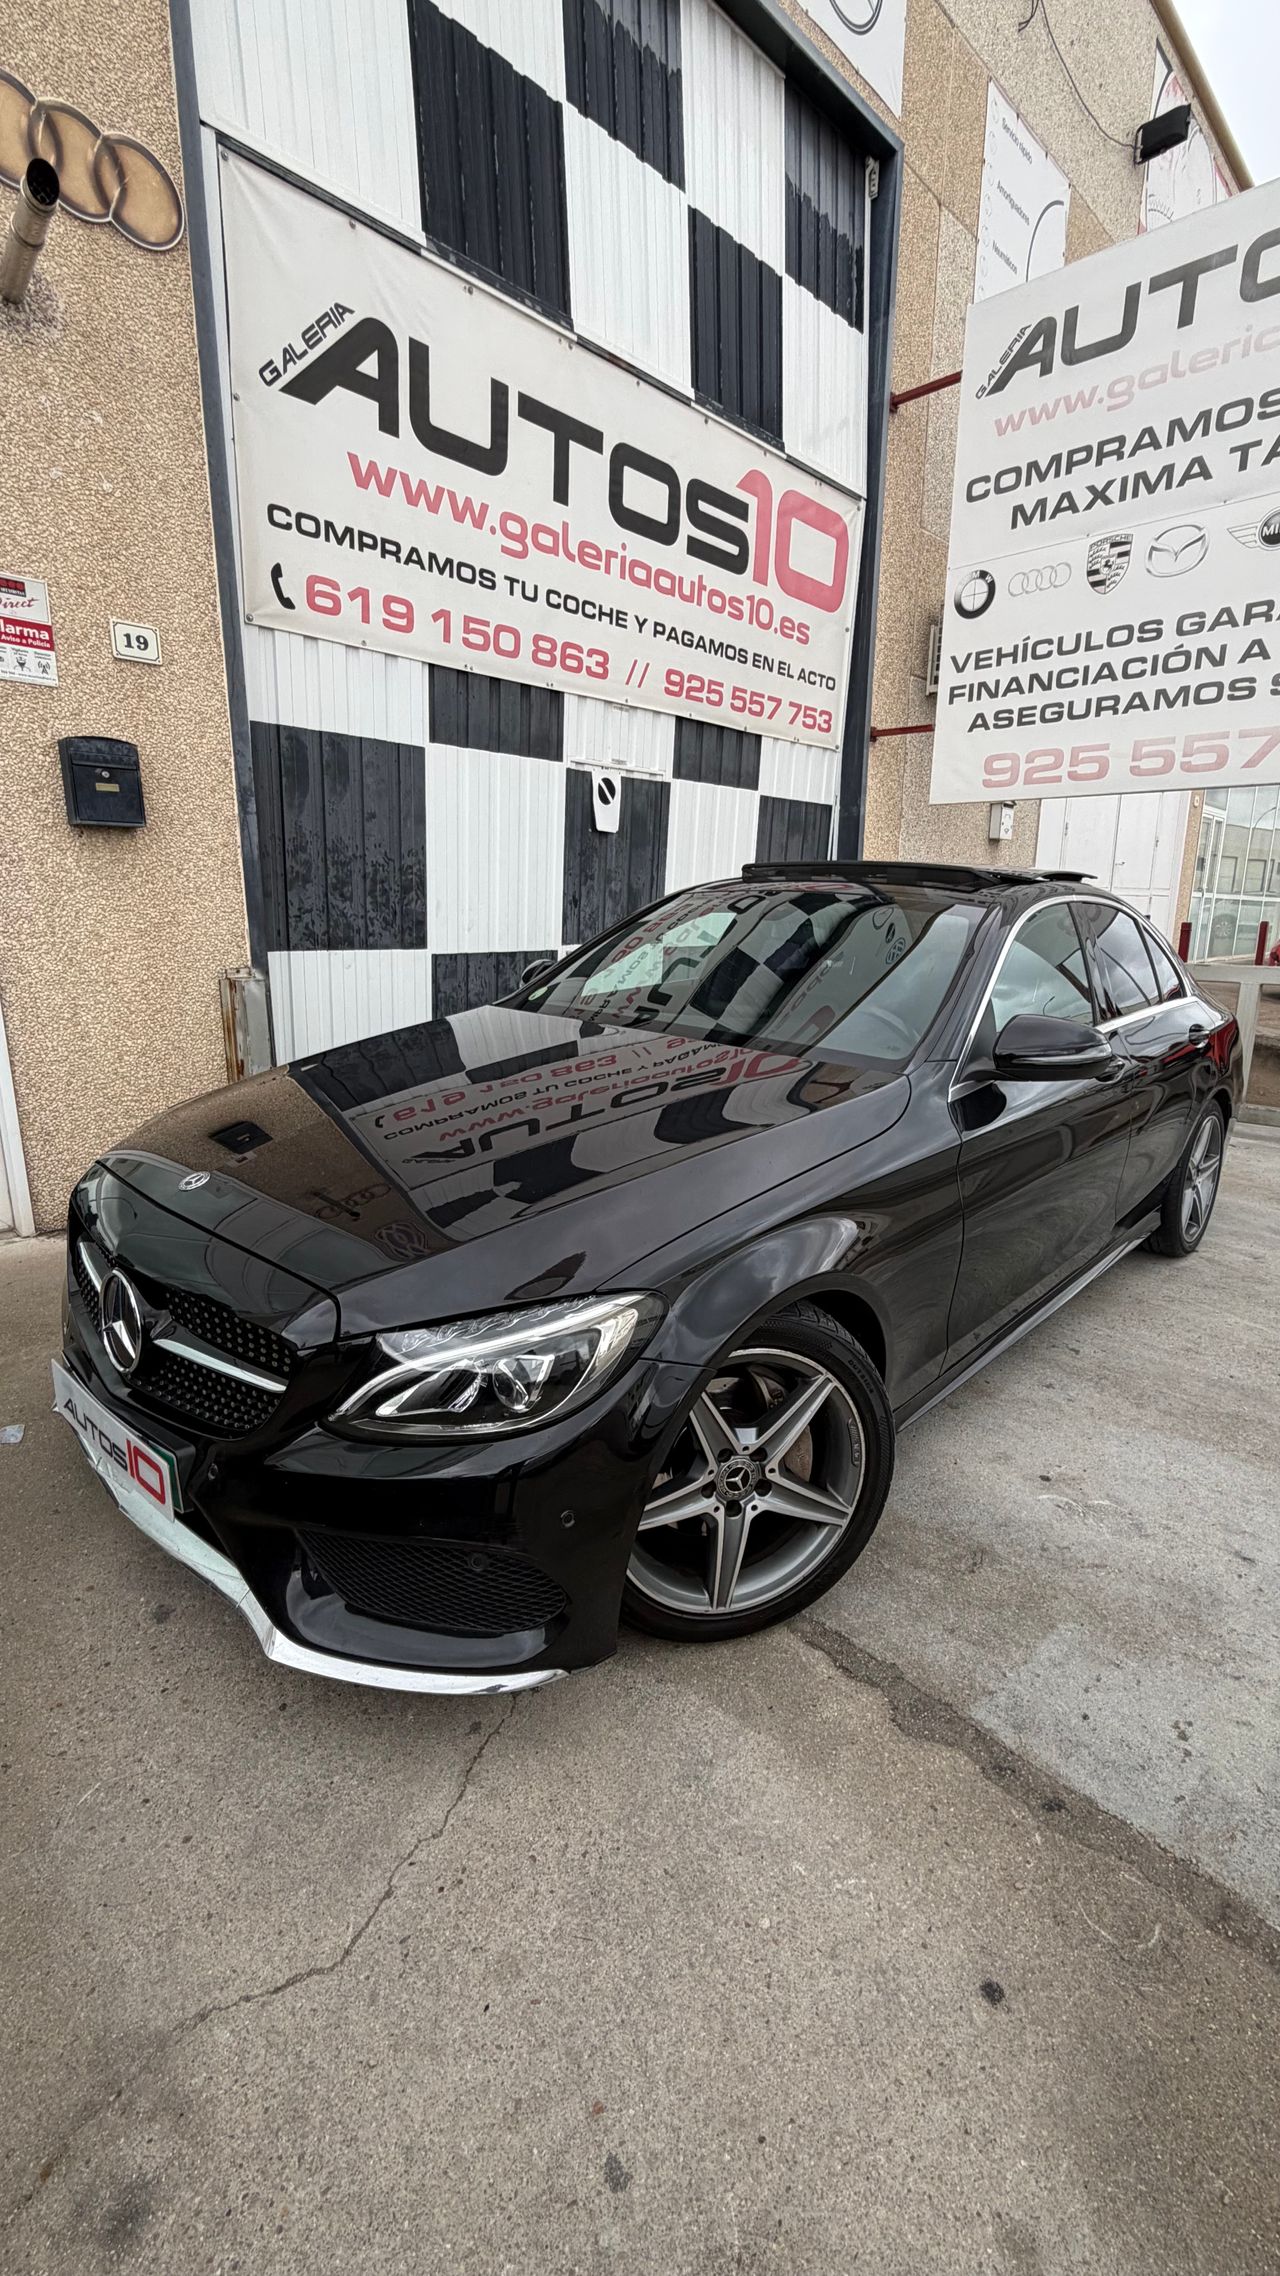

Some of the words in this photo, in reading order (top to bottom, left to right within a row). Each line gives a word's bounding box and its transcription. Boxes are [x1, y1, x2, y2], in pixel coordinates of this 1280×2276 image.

[258, 302, 355, 387] GALERIA
[975, 324, 1032, 400] GALERIA
[279, 317, 849, 615] AUTOS10
[966, 387, 1280, 504] COMPRAMOS
[1010, 455, 1213, 530] MAXIMA
[1262, 523, 1280, 537] MI
[347, 452, 810, 647] www.galeriaautos10.es
[267, 503, 497, 592] COMPRAMOS
[503, 575, 539, 604] TU
[545, 588, 629, 630] COCHE
[634, 615, 648, 634] Y
[653, 621, 748, 666] PAGAMOS
[752, 652, 775, 673] EN
[777, 660, 794, 680] EL
[797, 668, 836, 692] ACTO
[123, 632, 149, 651] 19
[305, 574, 415, 635] 619
[431, 608, 522, 661] 150
[531, 633, 610, 682] 863
[662, 667, 725, 708] 925
[729, 686, 783, 721] 557
[787, 701, 833, 734] 753
[948, 643, 1228, 706] FINANCIACIÓN
[1237, 638, 1272, 665] A
[950, 618, 1164, 674] VEHÍCULOS
[1175, 599, 1280, 637] GAR
[967, 676, 1257, 733] ASEGURAMOS
[981, 742, 1111, 790] 925
[1129, 725, 1280, 779] 557
[64, 1398, 166, 1505] AUTOS10
